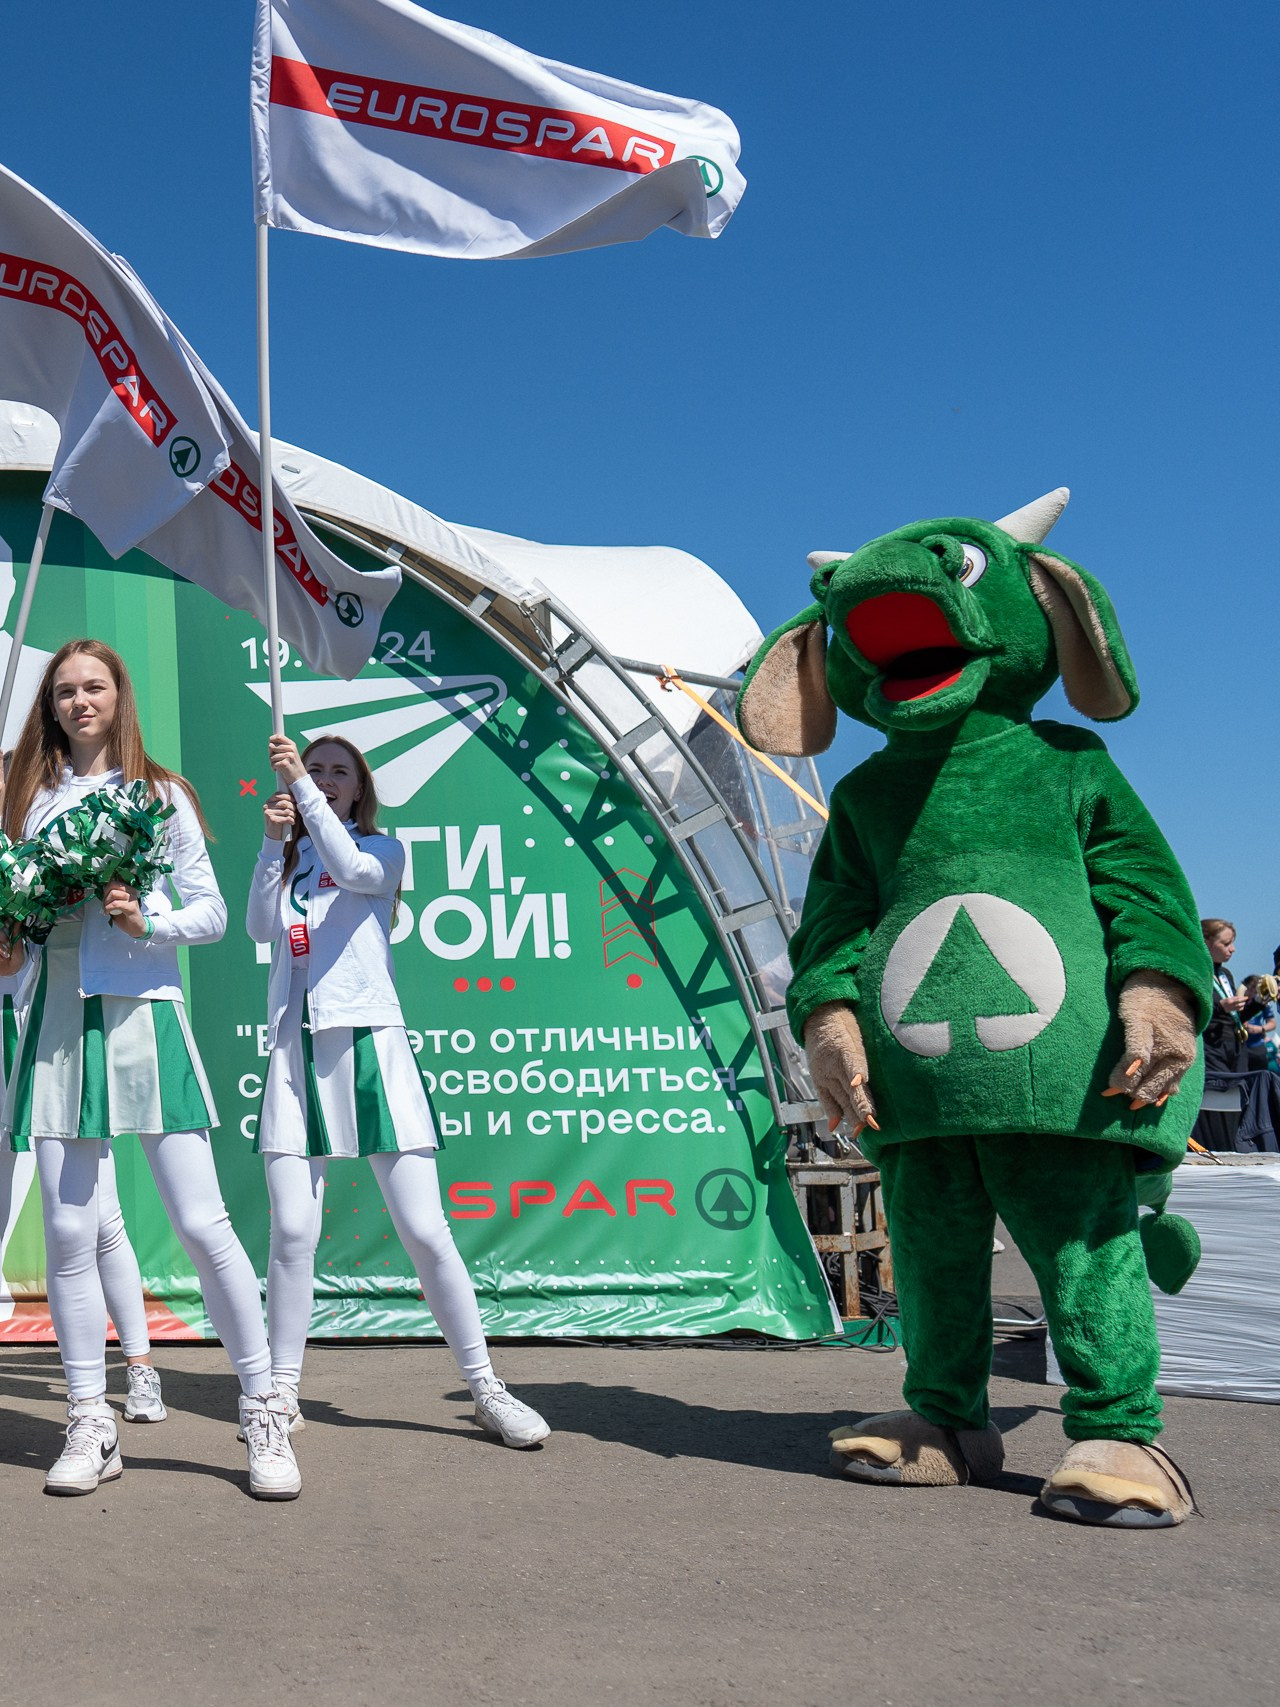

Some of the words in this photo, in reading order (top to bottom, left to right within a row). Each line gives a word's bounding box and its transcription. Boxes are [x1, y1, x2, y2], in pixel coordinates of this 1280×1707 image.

[326, 82, 665, 169] EUROSPAR
[241, 630, 436, 670] 19..24
[380, 824, 526, 895] ГИ,
[489, 1016, 713, 1054] отличный
[487, 1110, 512, 1136] и
[526, 1099, 744, 1143] стресса."
[447, 1179, 678, 1220] SPAR
